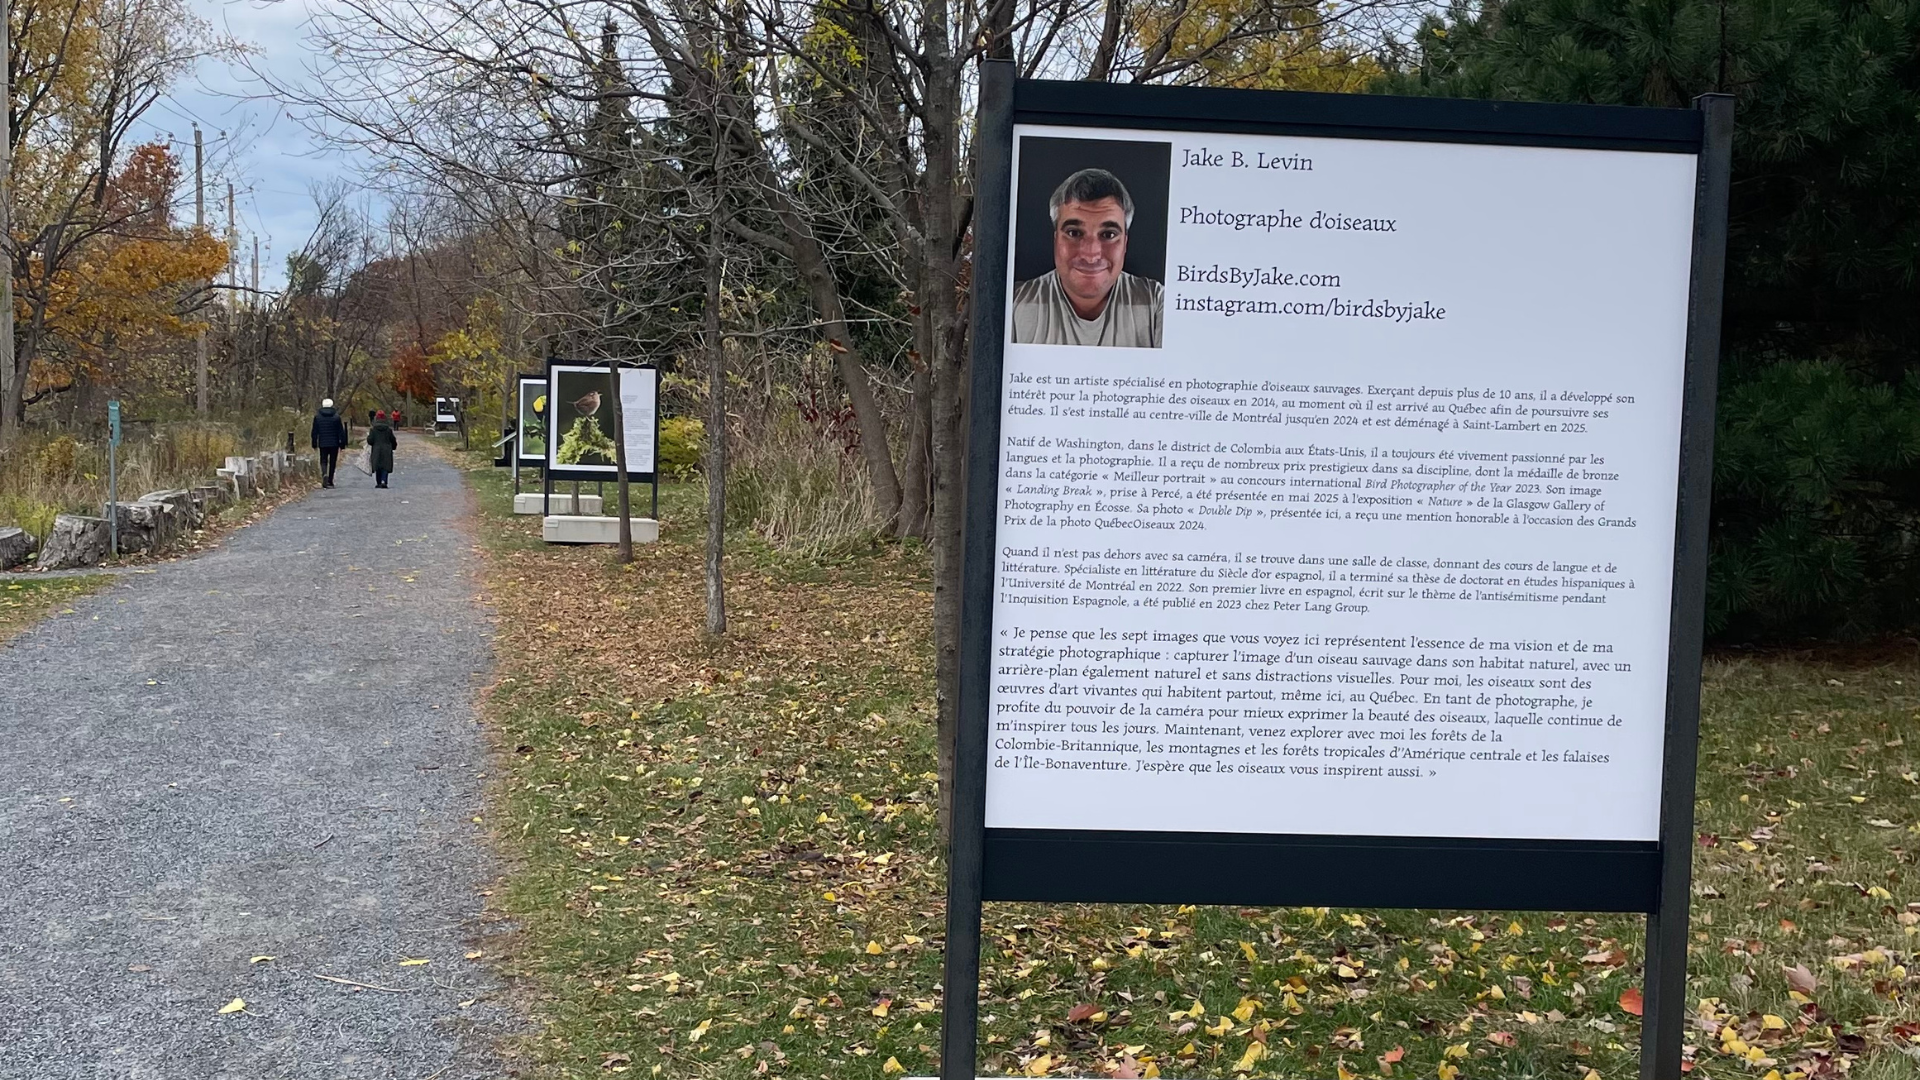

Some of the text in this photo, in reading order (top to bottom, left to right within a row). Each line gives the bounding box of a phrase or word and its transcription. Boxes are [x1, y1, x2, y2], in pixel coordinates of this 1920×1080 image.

[1181, 147, 1313, 171] Jake B. Levin
[1179, 204, 1303, 233] Photographe
[1176, 263, 1341, 289] BirdsByJake.com
[1175, 292, 1446, 323] instagram.com/birdsbyjake
[1009, 371, 1033, 384] Jake
[1035, 374, 1052, 384] est
[1054, 376, 1070, 385] un
[1073, 376, 1109, 386] artiste
[1112, 376, 1165, 389] spécialisé
[1168, 380, 1182, 389] en
[1185, 377, 1258, 393] photographie
[1312, 385, 1363, 396] sauvages.
[1367, 384, 1414, 398] Exerçant
[1417, 385, 1453, 400] depuis
[1456, 386, 1479, 400] plus
[1482, 387, 1496, 399] de
[1499, 389, 1511, 399] 10
[1514, 392, 1536, 401] ans,
[1539, 389, 1547, 400] il
[1550, 393, 1557, 401] a
[1559, 390, 1613, 405] développé
[1615, 395, 1635, 404] son
[1007, 435, 1604, 466] Natif de Washington, dans le district de Colombia aux États-Unis, il a toujours été vivement passionné par les
[1006, 450, 1619, 481] langues et la photographie. Il a reçu de nombreux prix prestigieux dans sa discipline, dont la médaille de bronze
[1003, 514, 1207, 530] Prix de la photo QuébecOiseaux 2024.
[1067, 578, 1082, 589] de
[1085, 579, 1135, 591] Montréal
[1138, 583, 1152, 592] en
[1156, 581, 1184, 592] 2022.
[1188, 582, 1208, 593] Son
[1211, 583, 1257, 596] premier
[1259, 583, 1285, 595] livre
[1288, 587, 1302, 596] en
[1305, 585, 1355, 599] espagnol,
[1358, 586, 1384, 598] écrit
[1386, 590, 1406, 598] sur
[1408, 587, 1418, 598] le
[1421, 587, 1456, 600] thème
[1458, 588, 1472, 600] de
[1561, 592, 1606, 605] pendant
[1072, 594, 1129, 608] Espagnole,
[1132, 599, 1140, 607] a
[1142, 596, 1159, 607] été
[1161, 596, 1196, 610] publié
[1198, 600, 1213, 609] en
[1215, 599, 1242, 609] 2023
[1244, 598, 1269, 610] chez
[1273, 600, 1301, 611] Peter
[1304, 601, 1332, 614] Lang
[1334, 601, 1370, 616] Group.
[998, 644, 1055, 660] stratégie
[1058, 644, 1161, 663] photographique
[1173, 650, 1229, 664] capturer
[1317, 652, 1358, 665] oiseau
[1361, 656, 1412, 669] sauvage
[1415, 653, 1447, 667] dans
[1451, 658, 1474, 668] son
[1478, 655, 1525, 669] habitat
[1528, 657, 1578, 672] naturel,
[1582, 662, 1610, 671] avec
[1613, 662, 1631, 672] un
[997, 663, 1592, 689] arrière-plan également naturel et sans distractions visuelles. Pour moi, les oiseaux sont des
[996, 699, 1622, 727] profite du pouvoir de la caméra pour mieux exprimer la beauté des oiseaux, laquelle continue de
[1070, 721, 1097, 733] tous
[1101, 720, 1119, 734] les
[1122, 721, 1159, 736] jours.
[1163, 723, 1244, 738] Maintenant,
[1247, 727, 1286, 737] venez
[1289, 725, 1344, 741] explorer
[1346, 730, 1375, 739] avec
[1379, 728, 1405, 740] moi
[1409, 727, 1427, 741] les
[1430, 727, 1467, 742] forêts
[1470, 729, 1487, 742] de
[1490, 729, 1503, 742] la
